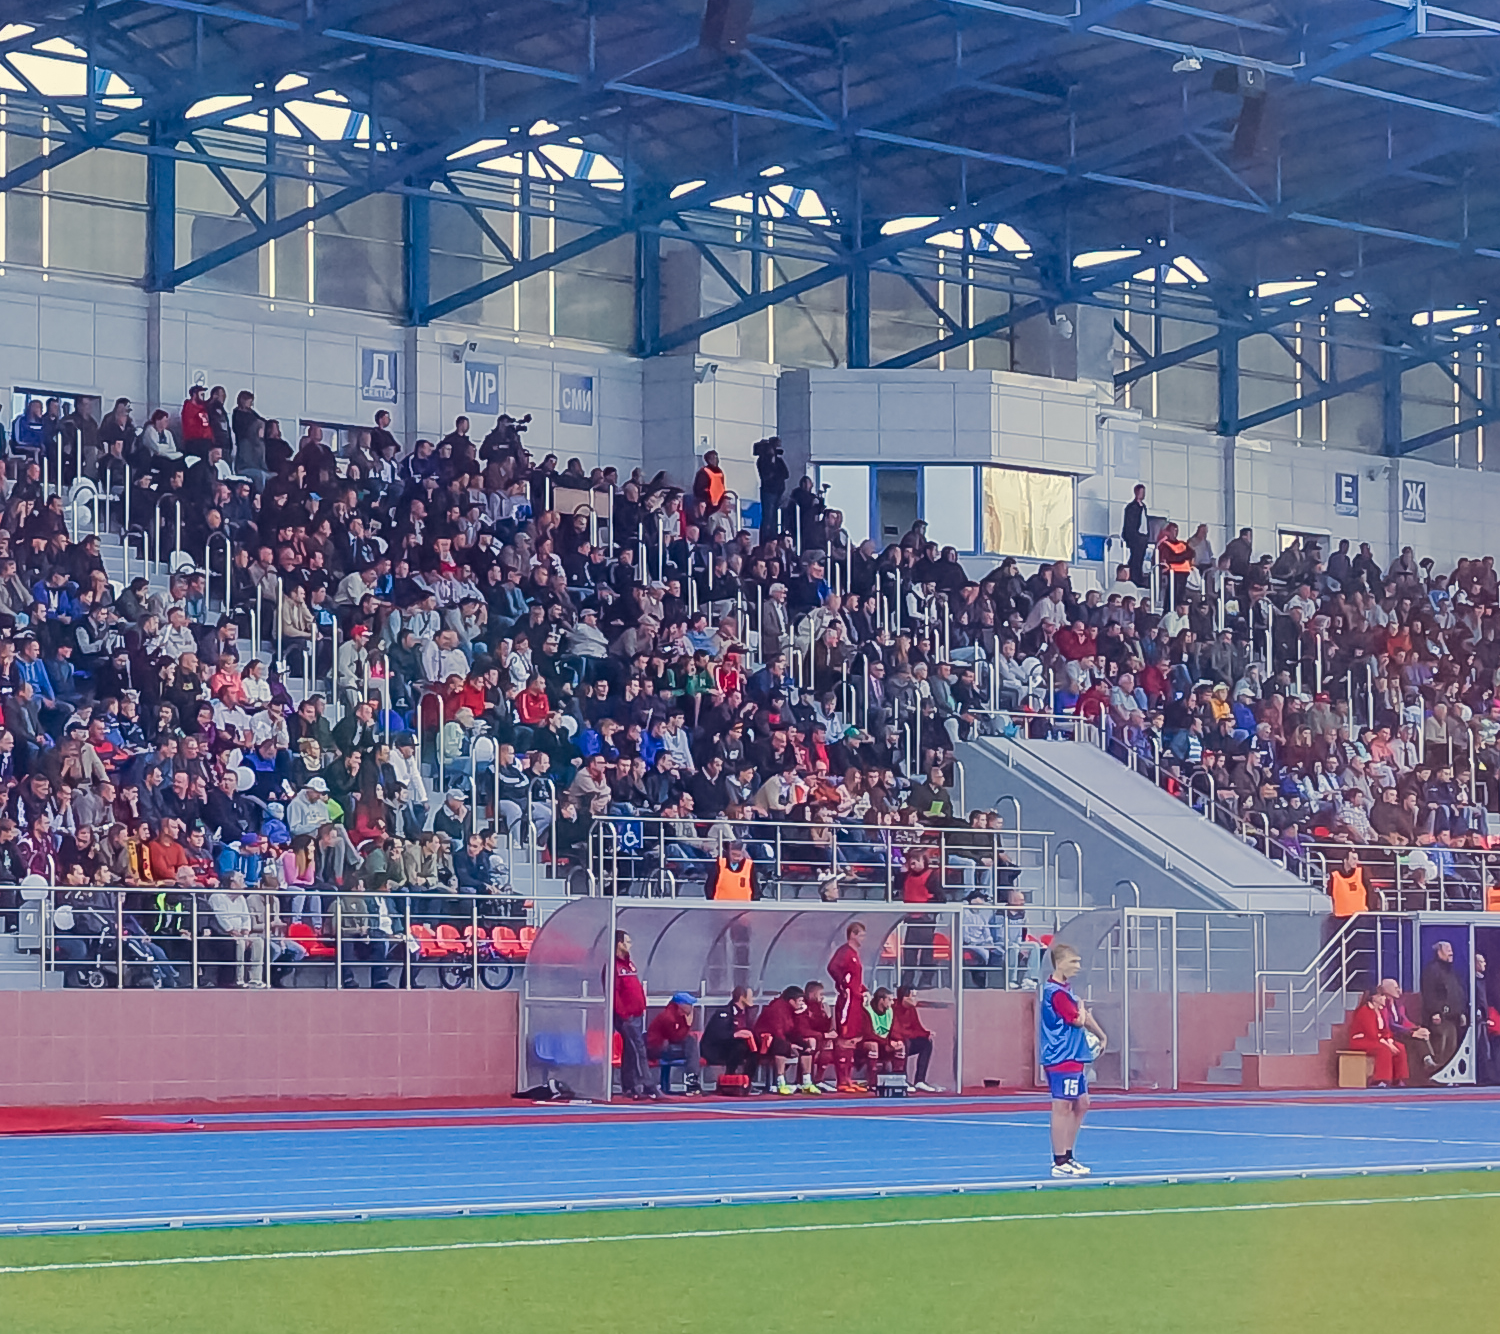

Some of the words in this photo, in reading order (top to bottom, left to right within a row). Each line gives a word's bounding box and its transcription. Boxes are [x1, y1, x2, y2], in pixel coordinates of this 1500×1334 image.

[369, 353, 392, 388] Д
[466, 370, 496, 404] VIP
[562, 387, 592, 413] СМИ
[1341, 475, 1354, 504] Е
[1404, 482, 1424, 510] Ж
[1063, 1078, 1079, 1096] 15
